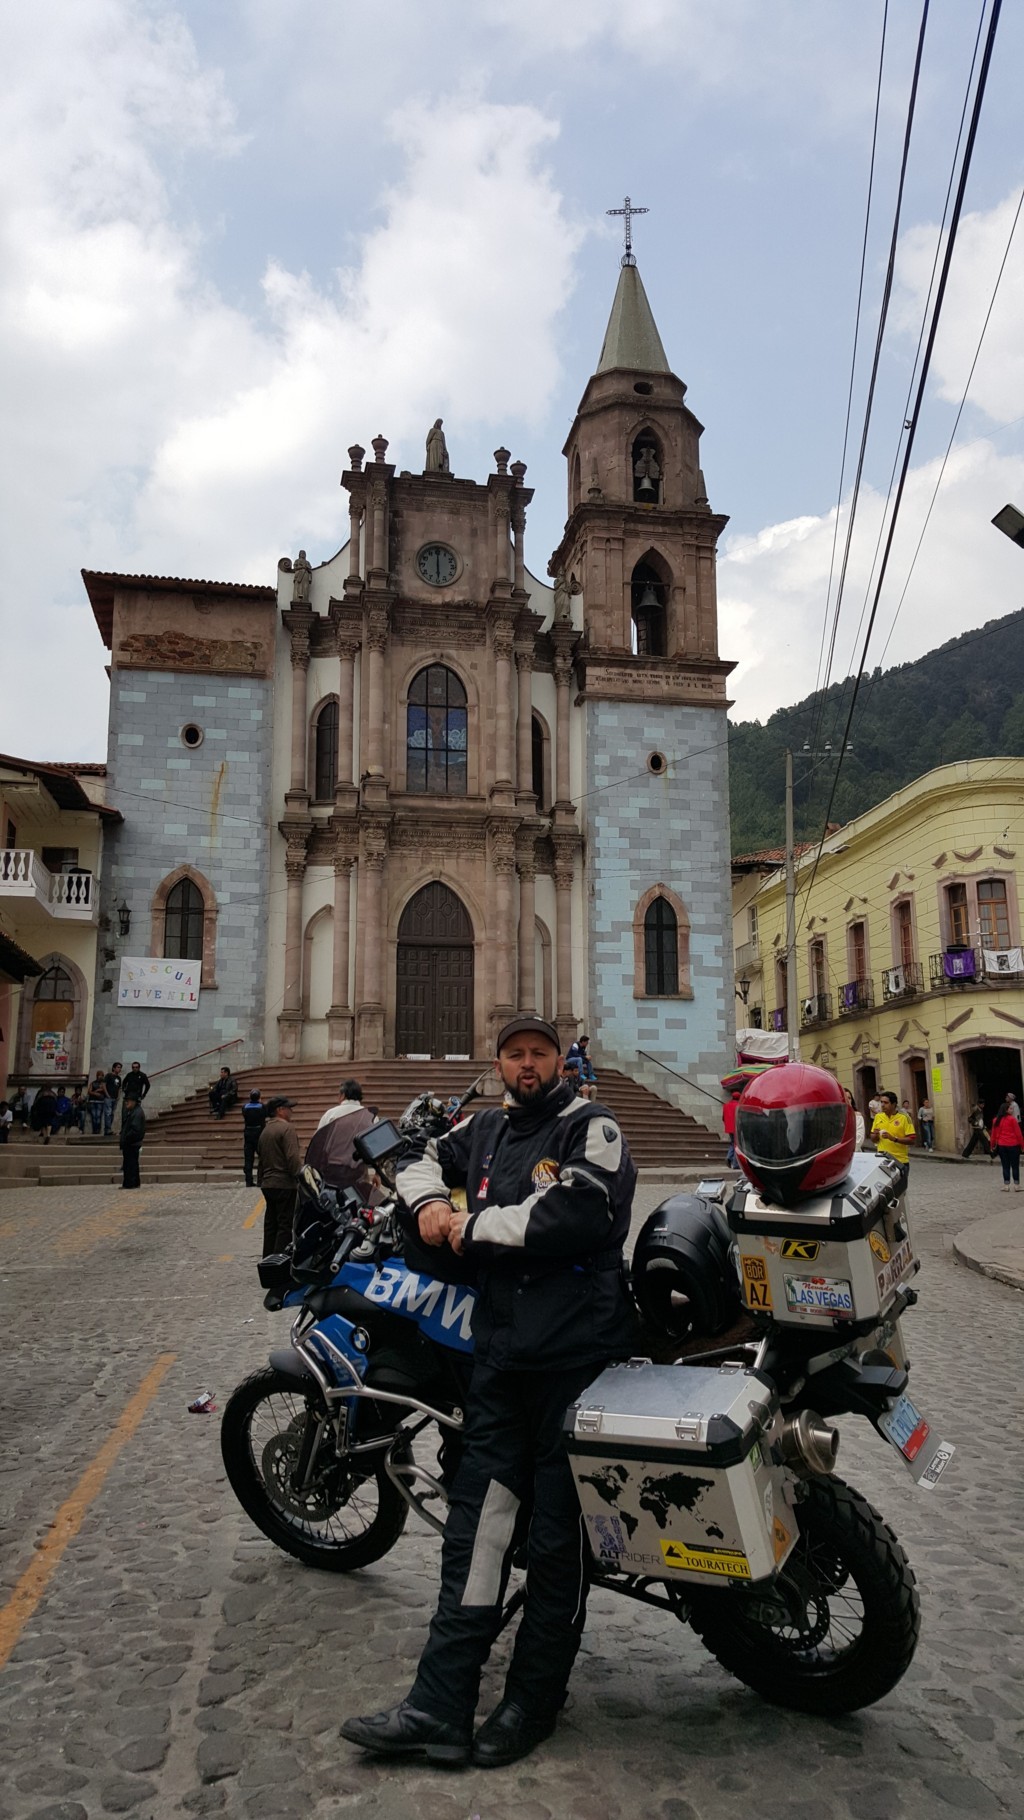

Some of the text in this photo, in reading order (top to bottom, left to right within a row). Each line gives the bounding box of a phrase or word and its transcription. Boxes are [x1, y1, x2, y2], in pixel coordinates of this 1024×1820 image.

[127, 965, 192, 985] PASCUA
[121, 989, 197, 1002] JUVENIL
[746, 1265, 764, 1279] BDR
[750, 1283, 771, 1307] AZ
[802, 1282, 834, 1292] Nevada
[363, 1267, 476, 1341] BMW
[794, 1289, 852, 1309] LAS VEGAS
[599, 1549, 661, 1565] ALTRIDER
[683, 1556, 749, 1575] TOURATECH
